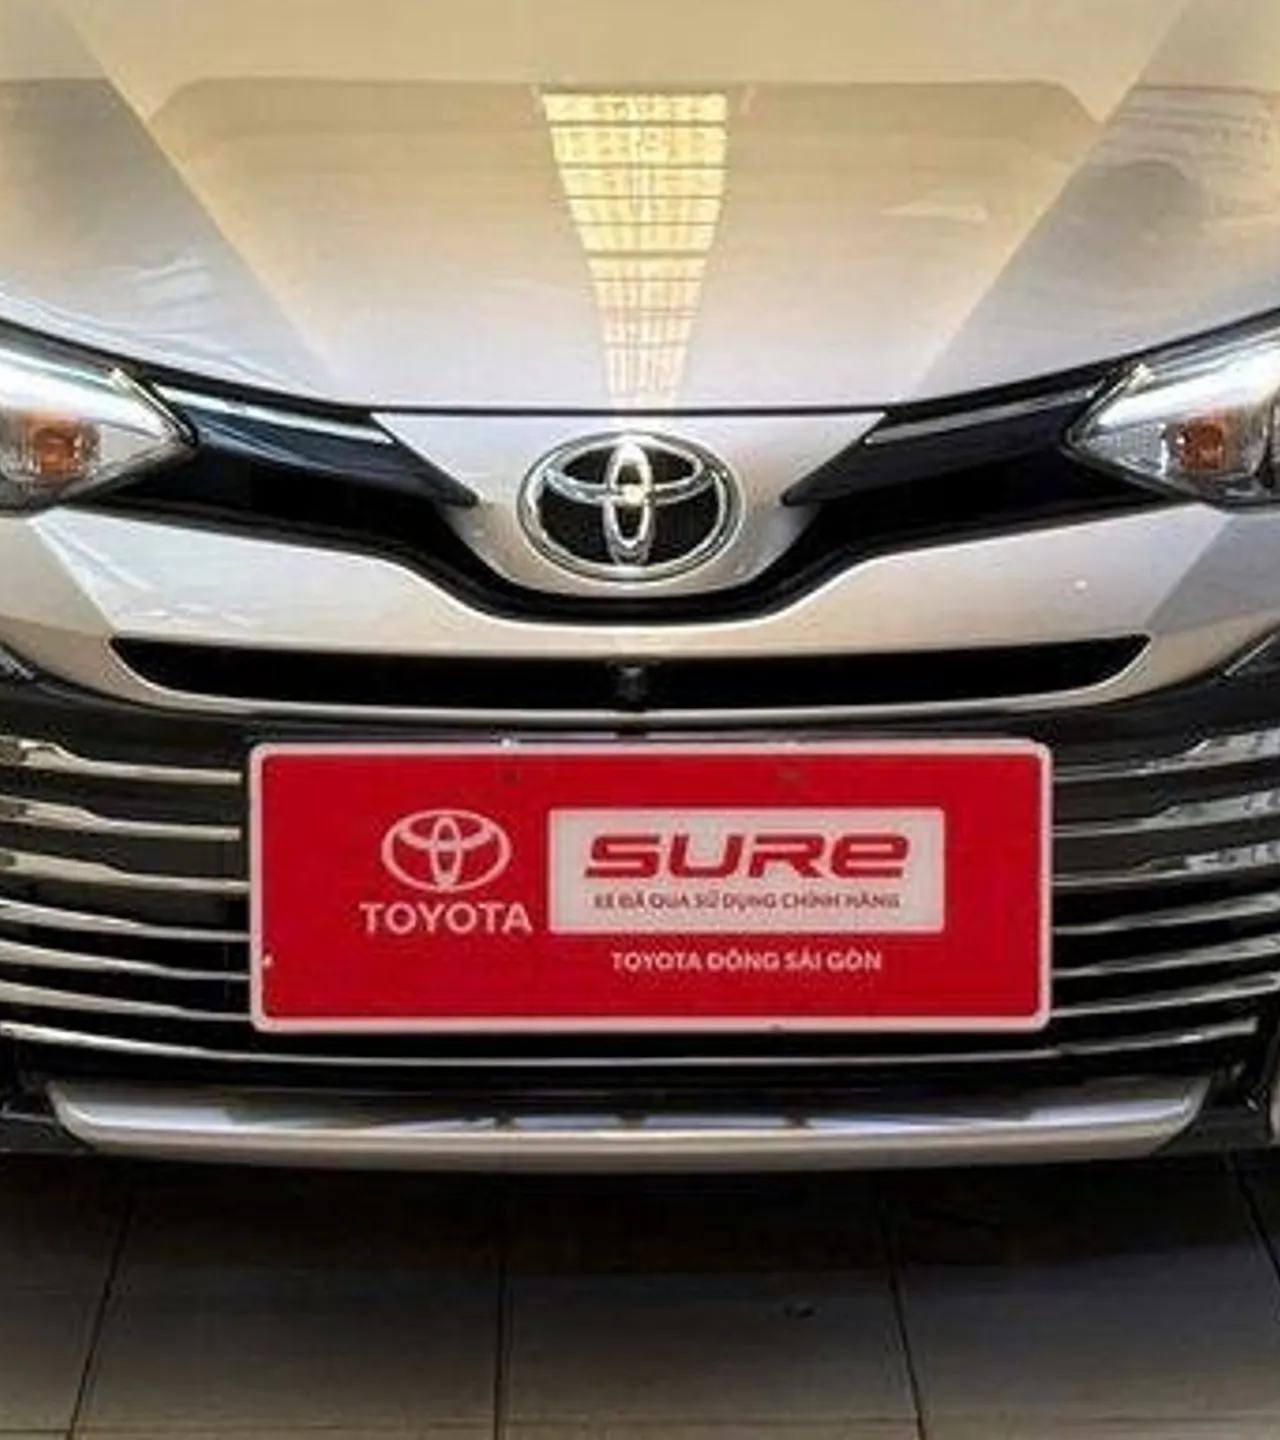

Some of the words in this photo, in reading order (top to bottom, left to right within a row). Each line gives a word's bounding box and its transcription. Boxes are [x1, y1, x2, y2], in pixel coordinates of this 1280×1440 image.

[648, 892, 690, 910] QUA
[723, 892, 777, 912] DỤNG
[782, 889, 840, 909] CHÍNH
[359, 901, 533, 935] TOYOTA
[610, 950, 702, 972] TOYOTA
[706, 946, 781, 972] ĐÔNG
[826, 945, 882, 972] GÒN
